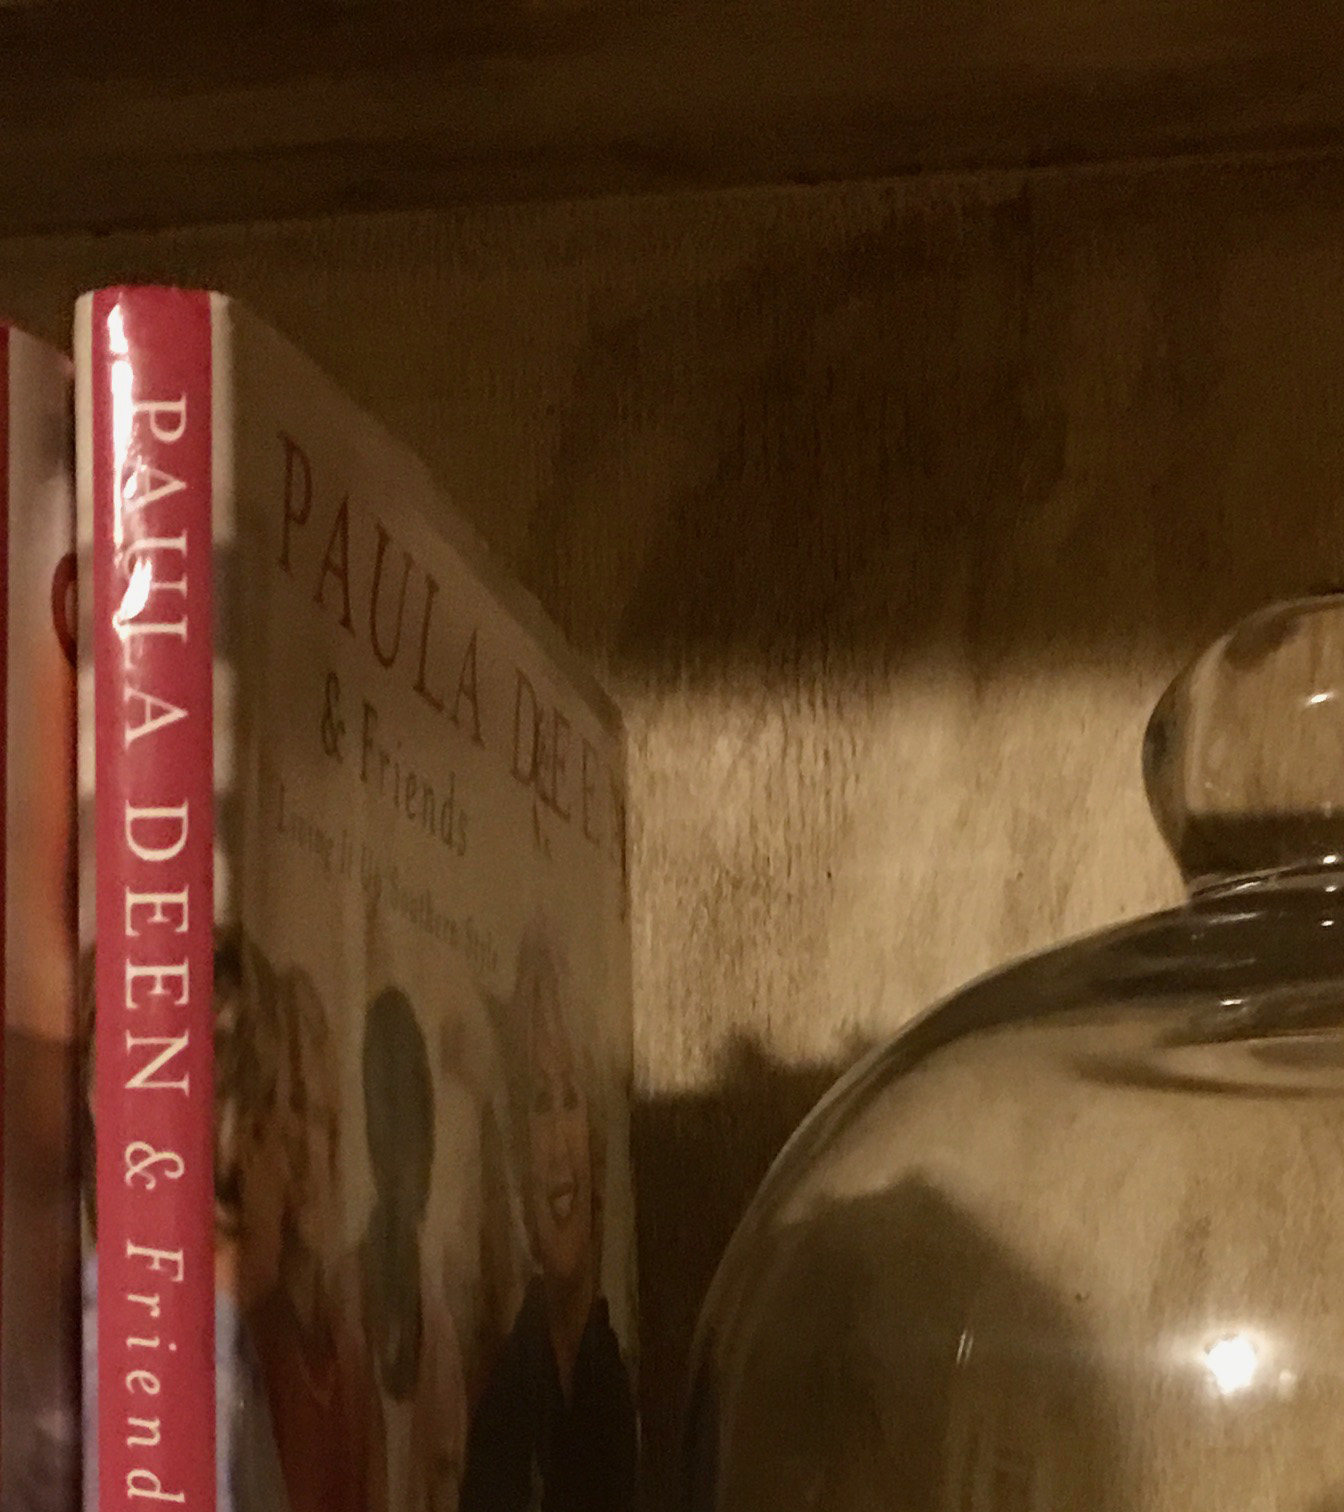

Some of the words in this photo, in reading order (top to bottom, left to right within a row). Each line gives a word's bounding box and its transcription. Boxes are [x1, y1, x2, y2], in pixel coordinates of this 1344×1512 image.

[118, 394, 188, 750] PAULA
[276, 430, 485, 750] PAULA
[124, 800, 190, 1096] DEEN
[123, 1140, 185, 1191] &
